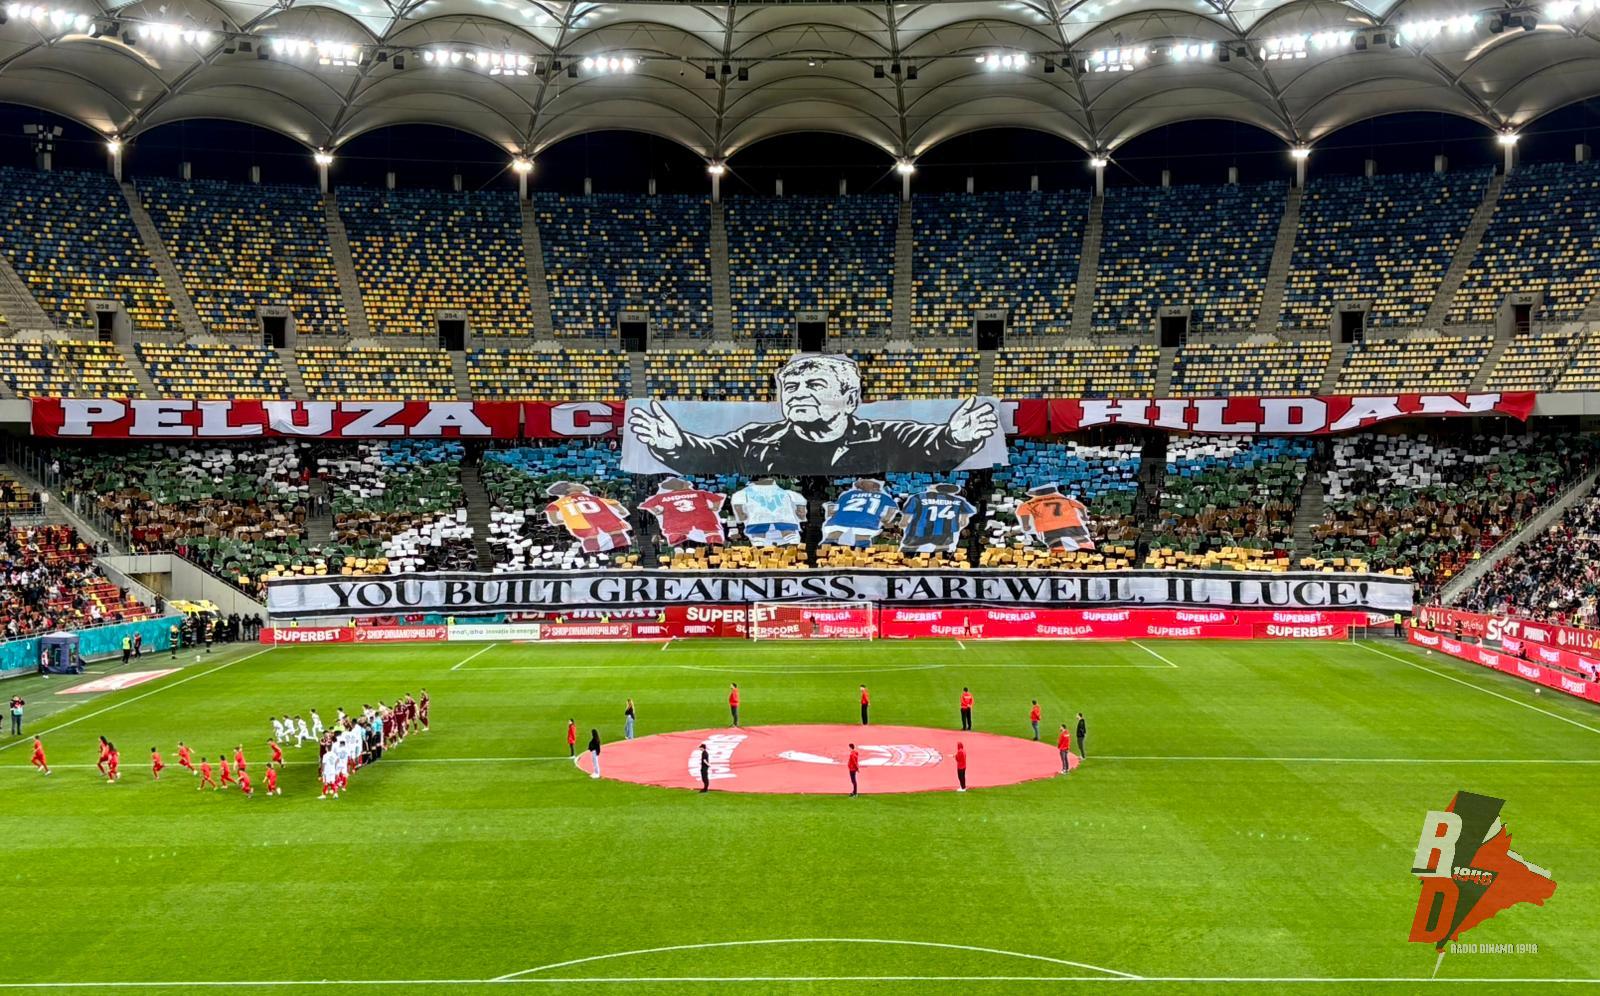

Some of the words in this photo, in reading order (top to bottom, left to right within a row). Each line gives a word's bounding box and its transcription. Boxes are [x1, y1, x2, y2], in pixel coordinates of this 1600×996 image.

[57, 400, 493, 437] PELUZA
[1078, 393, 1501, 433] HILDAN
[562, 500, 602, 516] 10
[673, 500, 696, 513] 3
[842, 498, 882, 516] 21
[1043, 501, 1062, 517] 7
[927, 505, 956, 522] 14
[328, 581, 424, 607] YOU
[443, 579, 573, 606] BUILT
[589, 576, 865, 602] GREATNESS.
[885, 577, 1146, 603] FAREWELL,
[1164, 578, 1210, 603] IL
[1229, 581, 1370, 606] LUCE!
[686, 606, 778, 623] SUPERBET
[803, 610, 851, 621] SUPERLIGA
[896, 611, 942, 621] SUPERBET
[987, 610, 1037, 621] SUPERLIGA
[1082, 611, 1130, 622] SUPERBET
[1176, 611, 1226, 622] SUPERLIGA
[1273, 612, 1322, 624] SUPERBET
[274, 628, 341, 642] SUPERBET
[637, 625, 660, 634] PUMA
[684, 625, 708, 634] PUMA
[735, 624, 800, 635] SUPERSCORE
[823, 624, 878, 635] SUPERLIGA
[931, 625, 984, 635] SUPERET
[1036, 624, 1093, 635] SUPERLIGA
[1147, 625, 1202, 636] SUPERBET
[1266, 624, 1333, 638] SUPERBET
[1567, 631, 1593, 648] HILS
